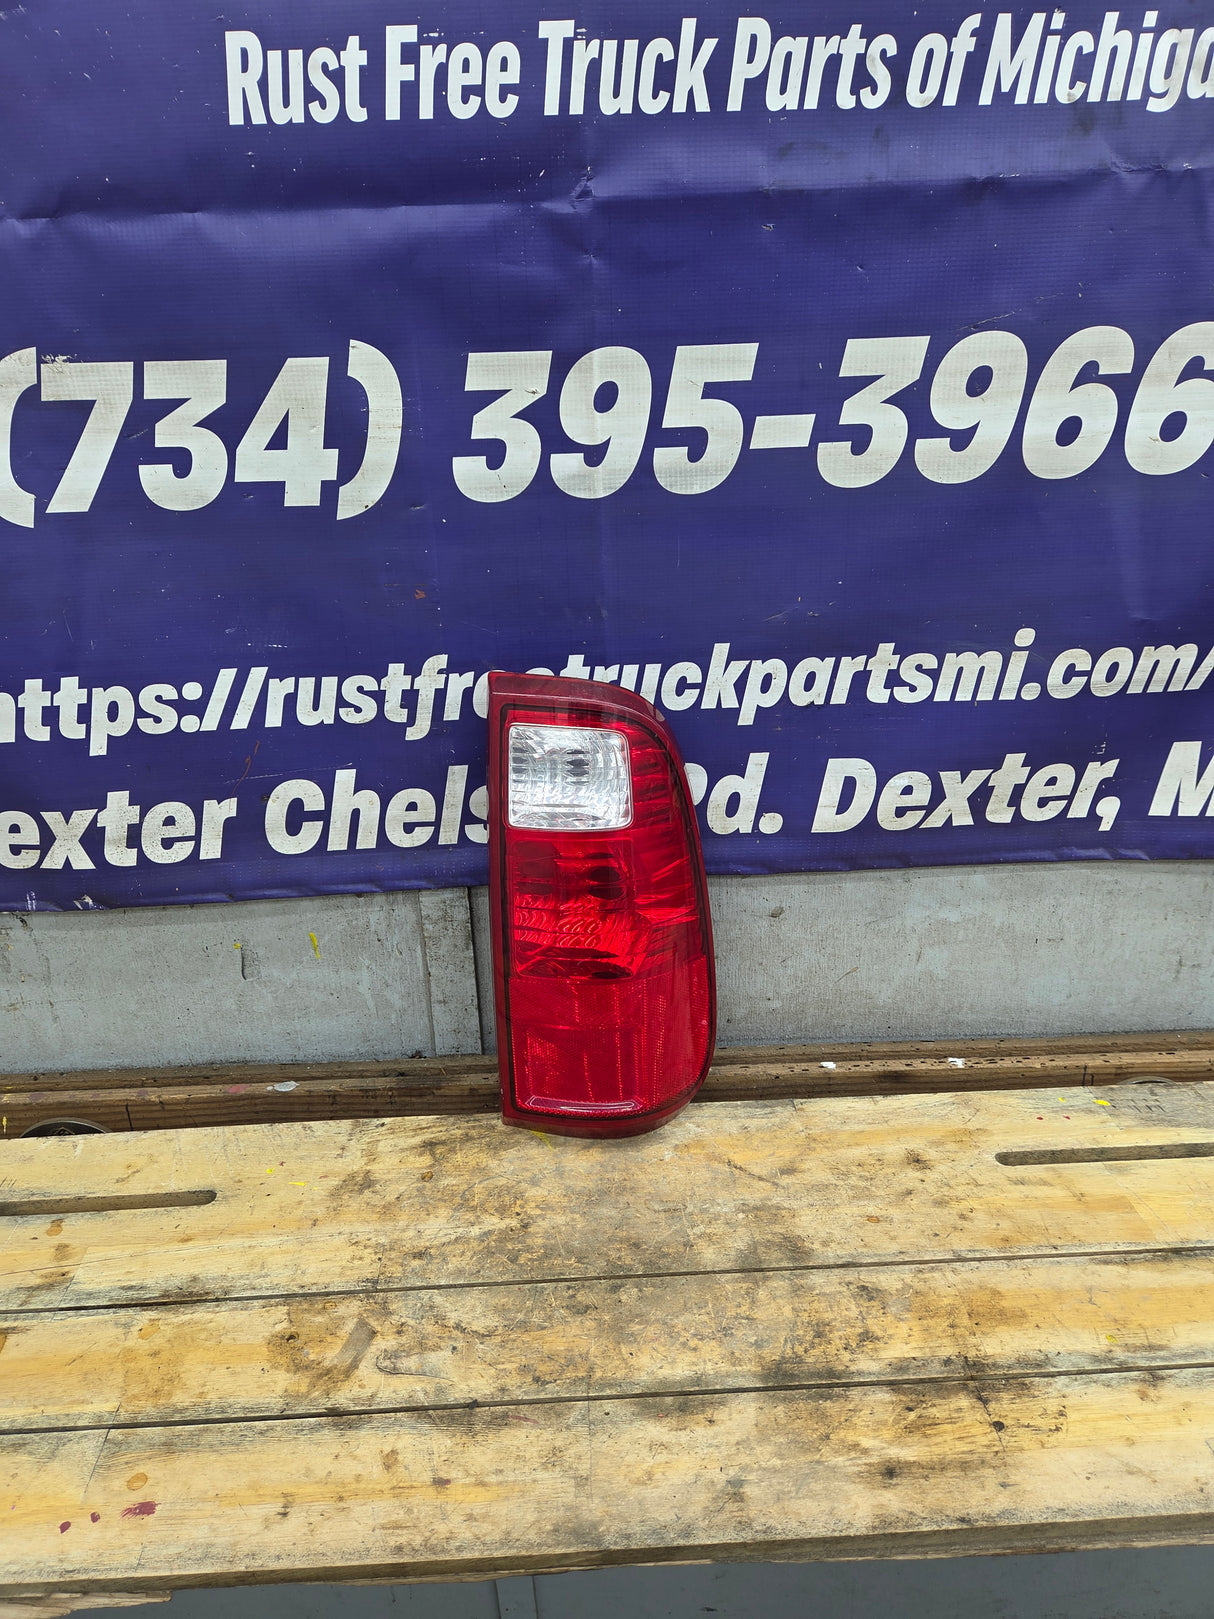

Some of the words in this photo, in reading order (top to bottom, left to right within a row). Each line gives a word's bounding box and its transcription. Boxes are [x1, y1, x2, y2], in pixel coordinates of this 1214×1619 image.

[224, 30, 368, 125] Rust
[385, 25, 521, 120] Free
[538, 17, 719, 116] Truck
[727, 17, 897, 112] Parts
[905, 13, 982, 108] of
[0, 339, 403, 528] (734)
[452, 321, 1214, 504] 395-3966
[811, 752, 1121, 834] Dexter,
